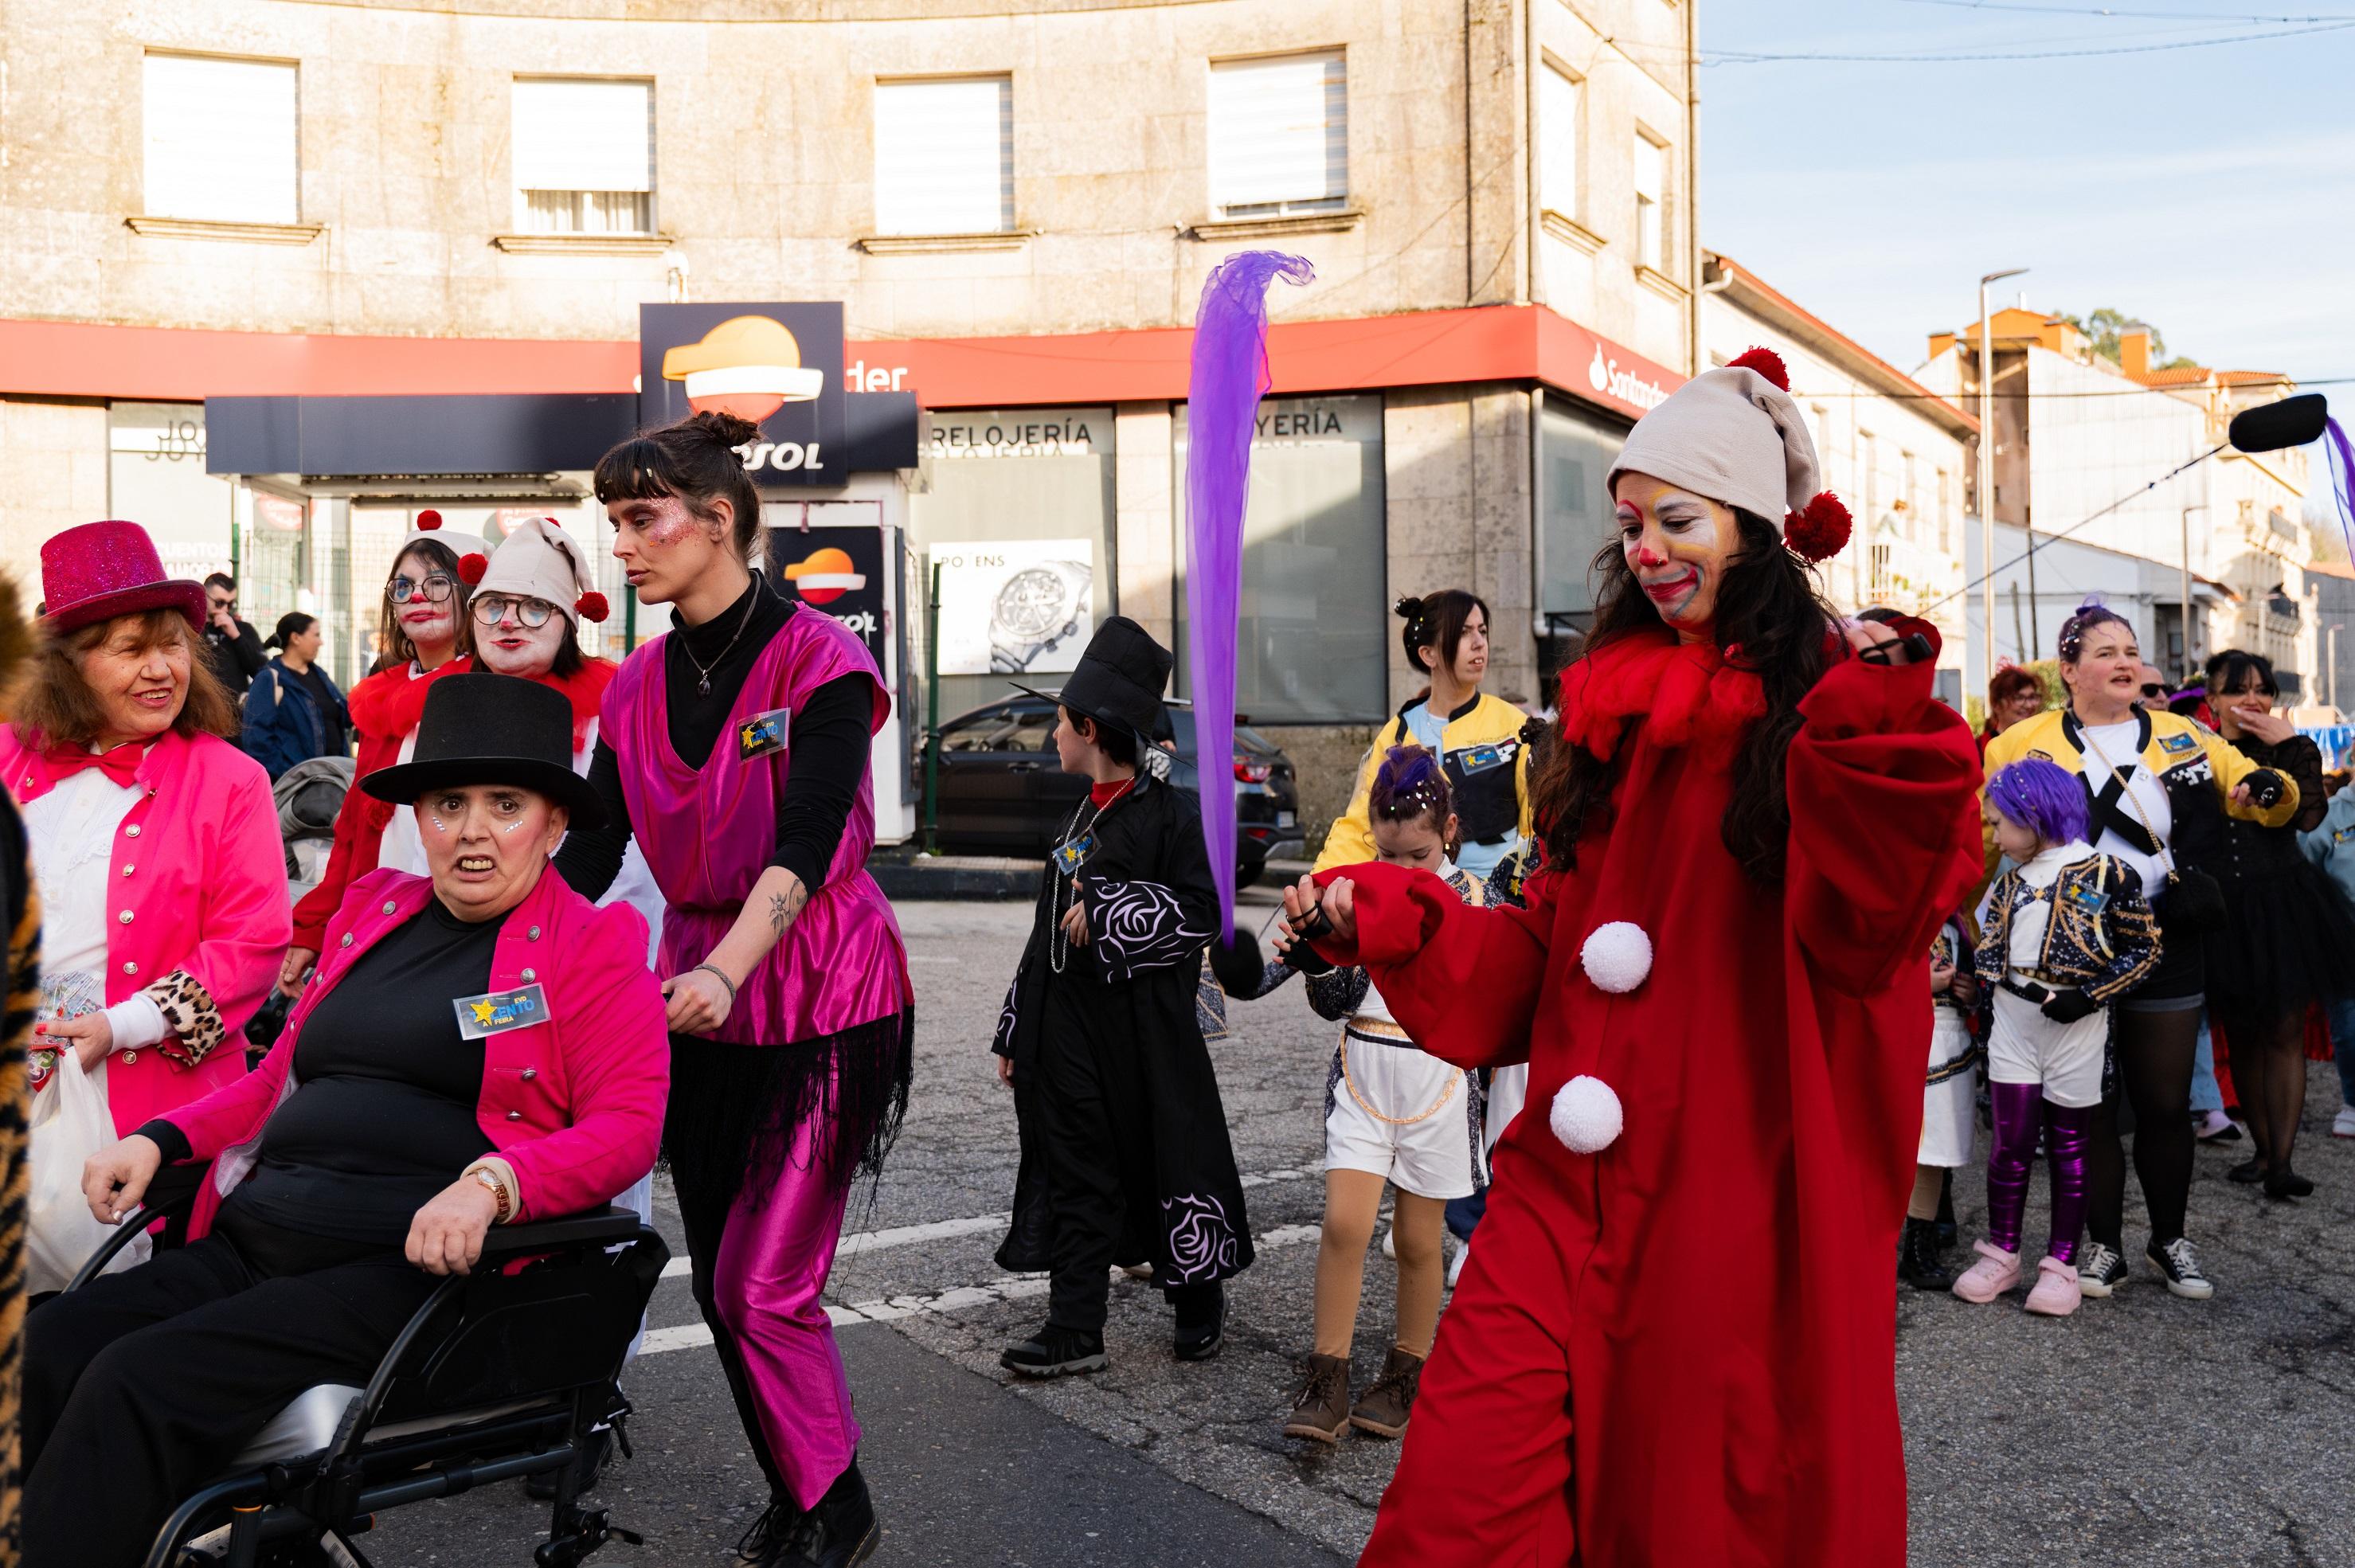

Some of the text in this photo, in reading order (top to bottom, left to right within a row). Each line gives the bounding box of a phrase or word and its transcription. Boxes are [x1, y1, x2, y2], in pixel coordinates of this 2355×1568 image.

[158, 420, 205, 440] JO
[933, 417, 1092, 447] RELOJERÍA
[941, 552, 1005, 568] POENS
[494, 1016, 514, 1026] FEIRA
